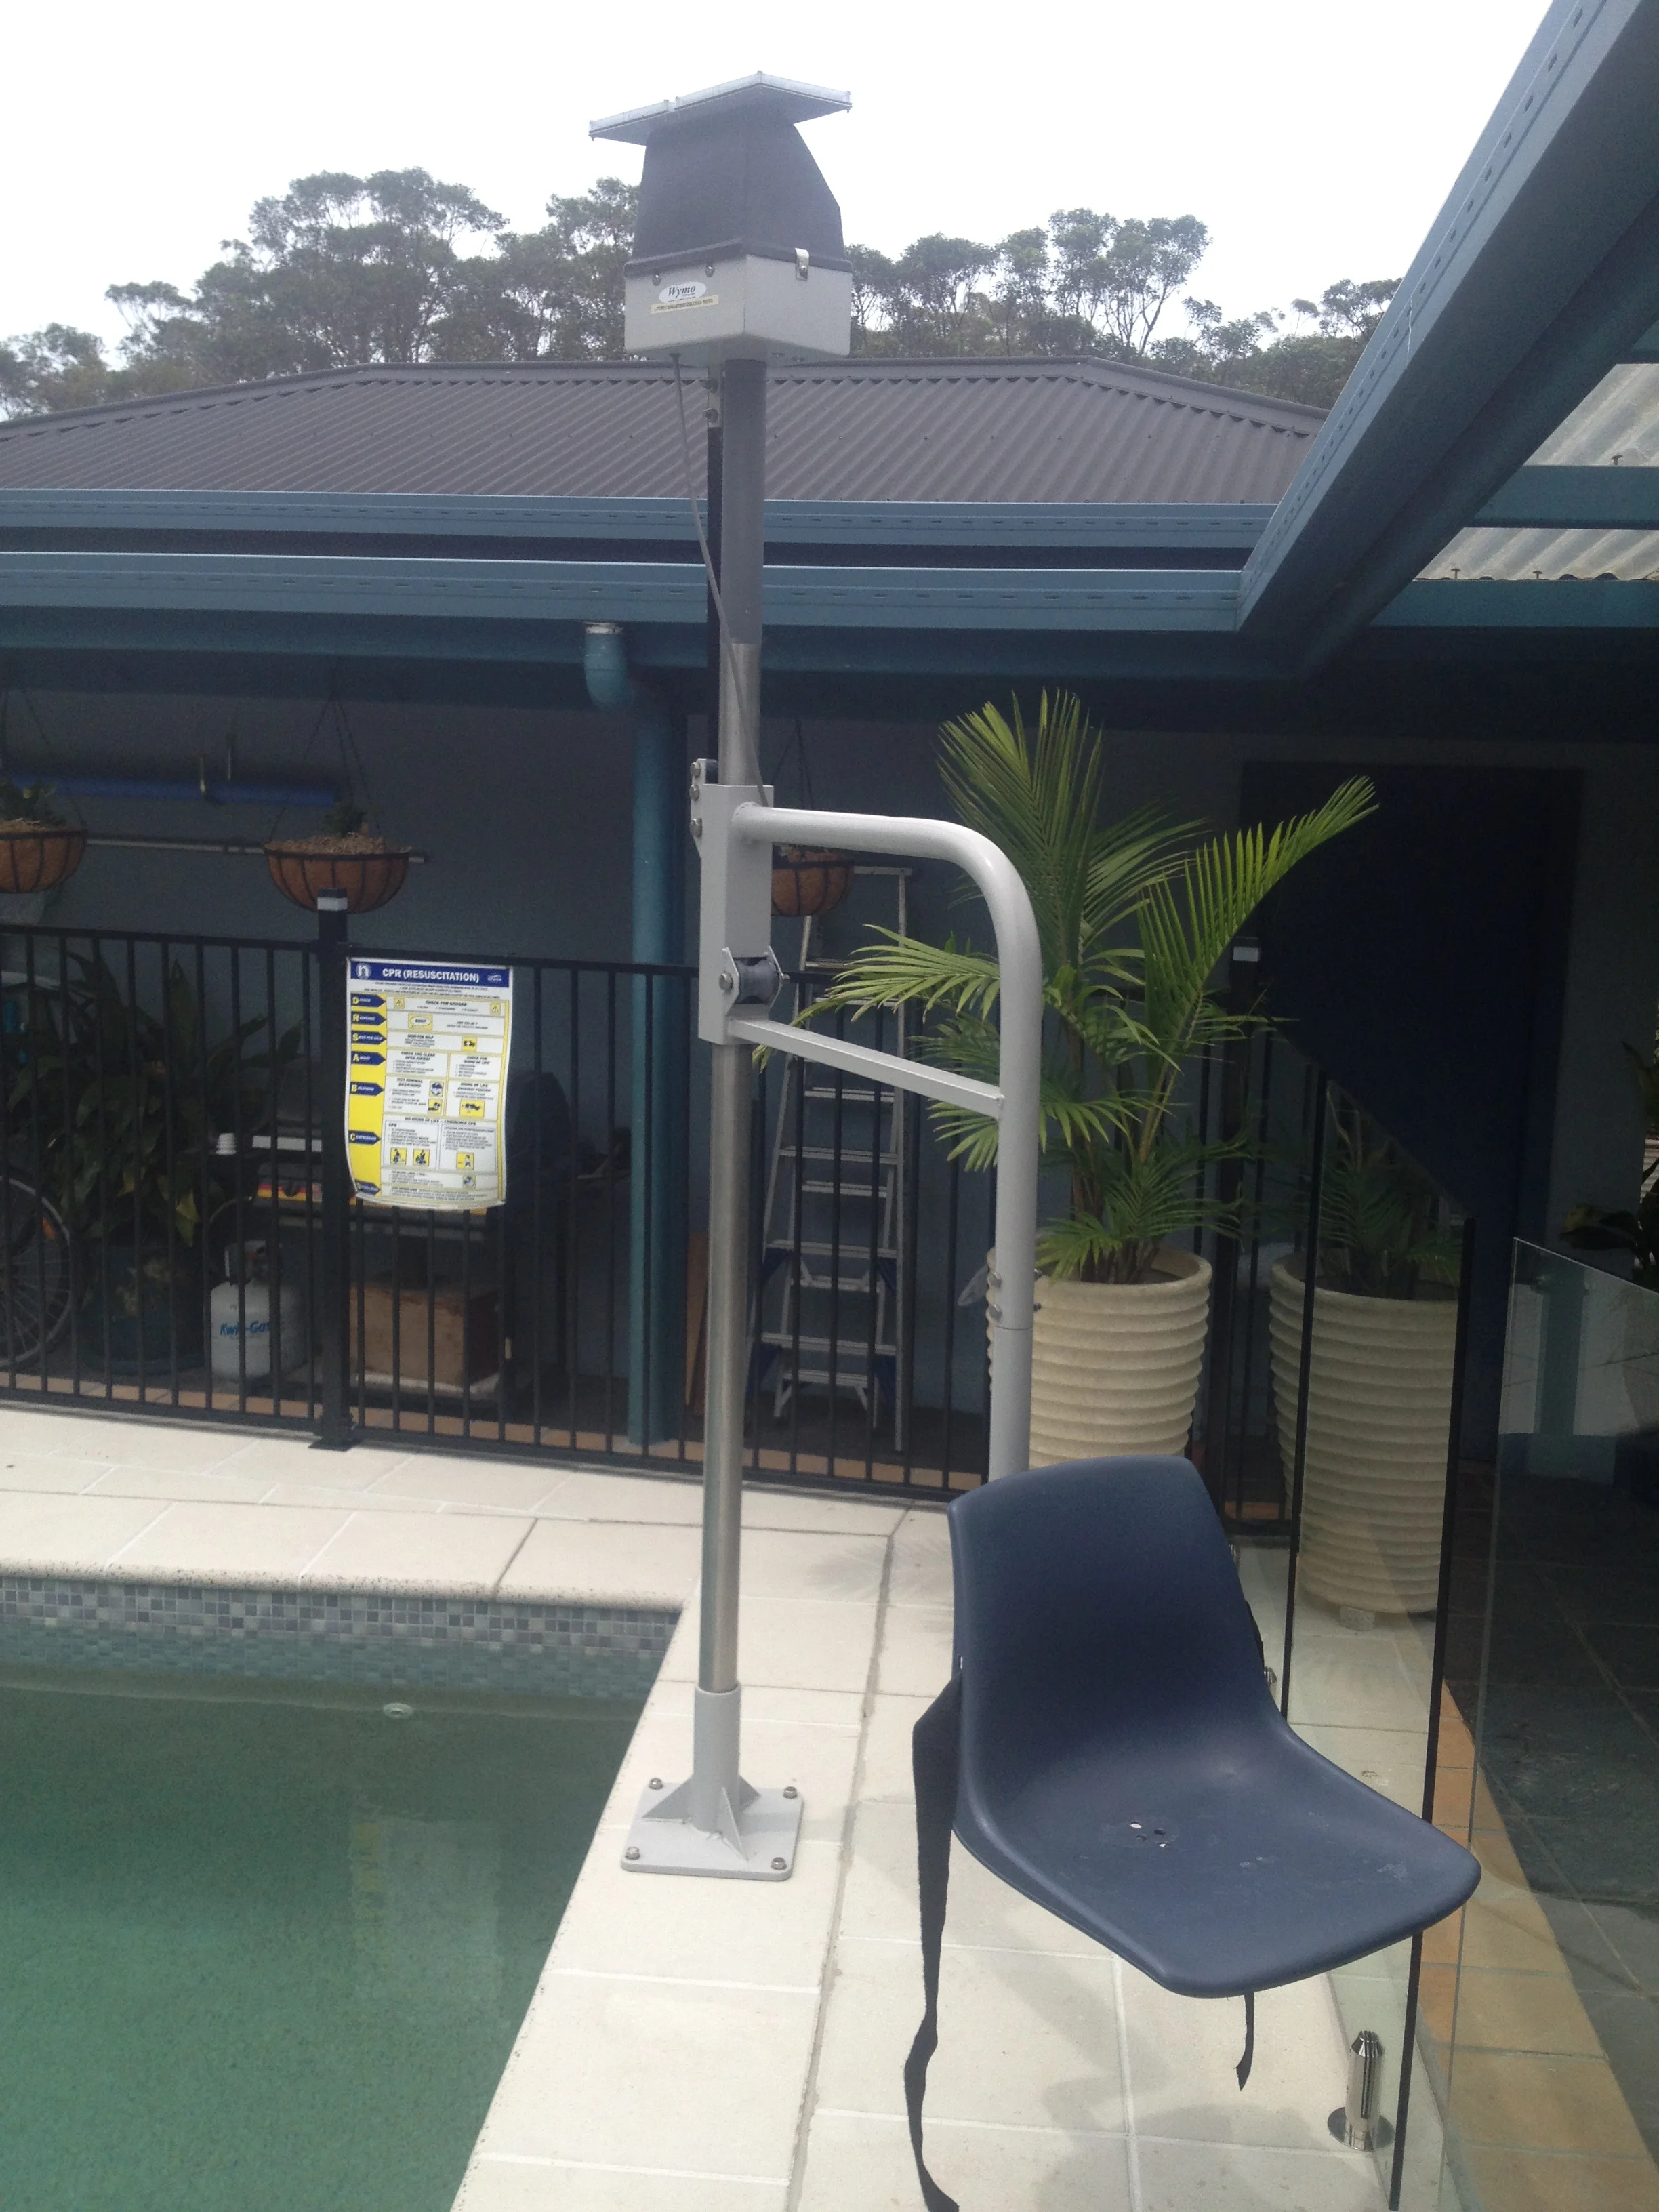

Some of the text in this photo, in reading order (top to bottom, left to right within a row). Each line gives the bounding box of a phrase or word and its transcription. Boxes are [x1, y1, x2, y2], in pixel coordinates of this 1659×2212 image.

[668, 286, 696, 298] Wymo
[382, 968, 402, 978] CPR
[403, 969, 479, 983] (RESUSCITATION)
